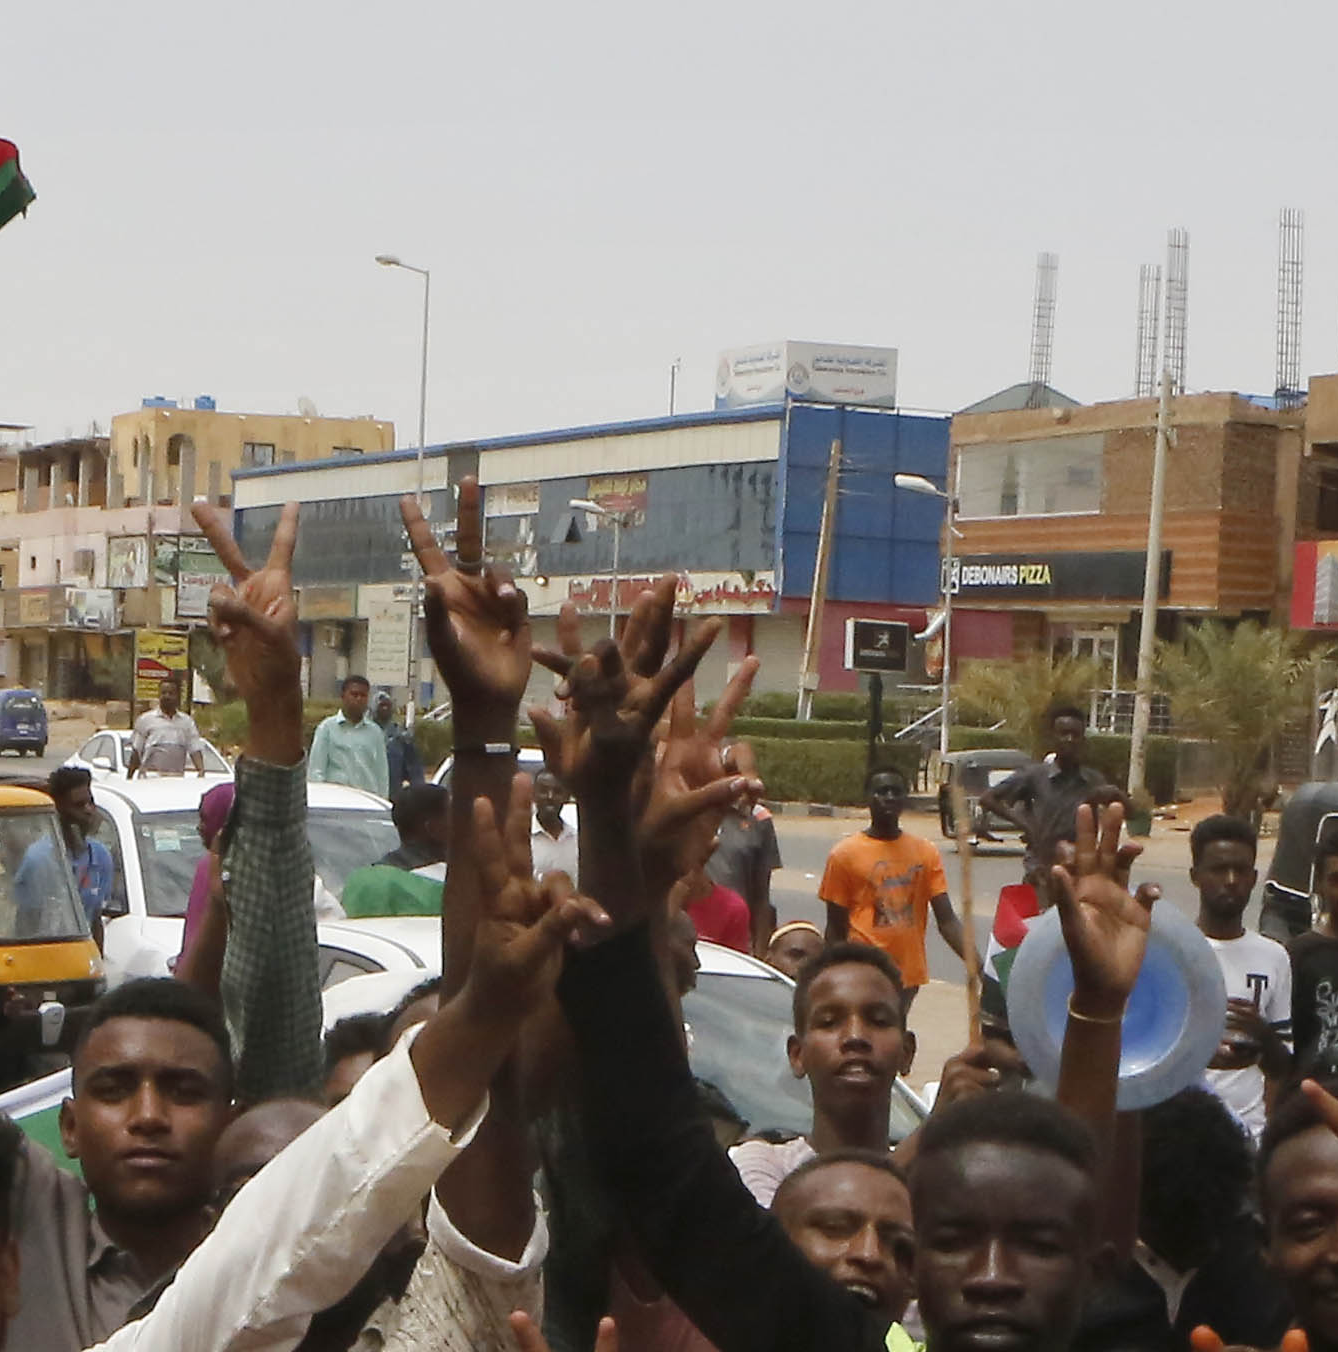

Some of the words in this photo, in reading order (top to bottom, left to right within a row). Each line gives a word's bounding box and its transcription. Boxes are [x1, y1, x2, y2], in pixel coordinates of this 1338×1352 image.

[961, 564, 1018, 585] DEBONAIRS
[1019, 563, 1052, 585] PIZZA
[1246, 972, 1269, 1010] T
